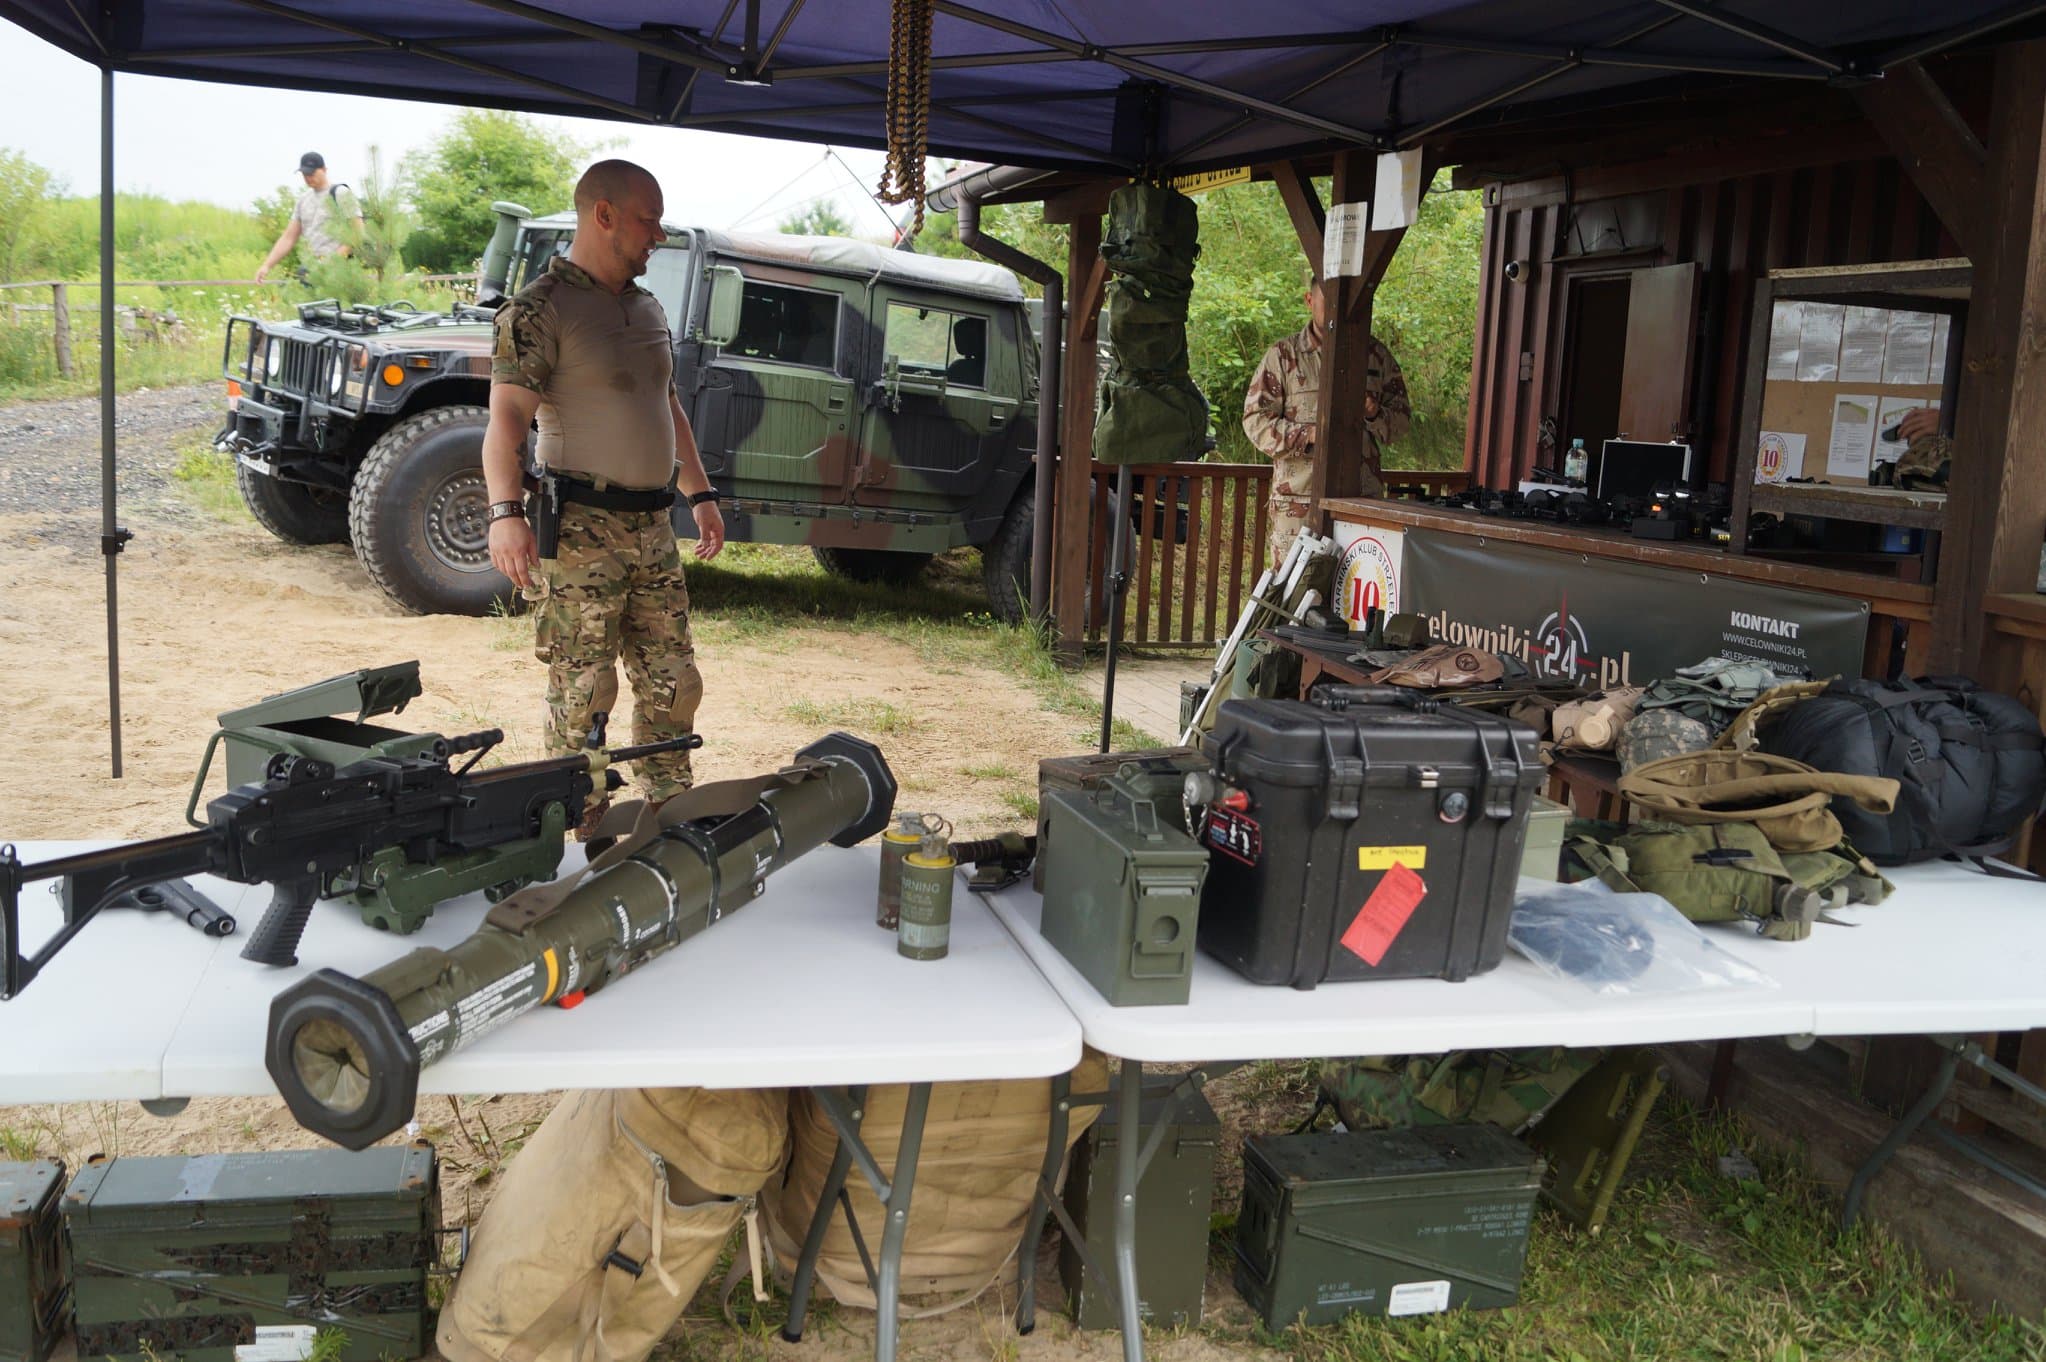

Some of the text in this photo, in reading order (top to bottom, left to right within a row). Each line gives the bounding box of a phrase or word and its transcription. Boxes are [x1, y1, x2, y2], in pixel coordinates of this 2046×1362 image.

[1761, 449, 1779, 467] 10
[1358, 543, 1377, 556] KLUB
[1351, 577, 1380, 622] 10
[1730, 610, 1800, 639] KONTAKT
[1721, 631, 1808, 659] WWW.CELOWNIKI24.PL
